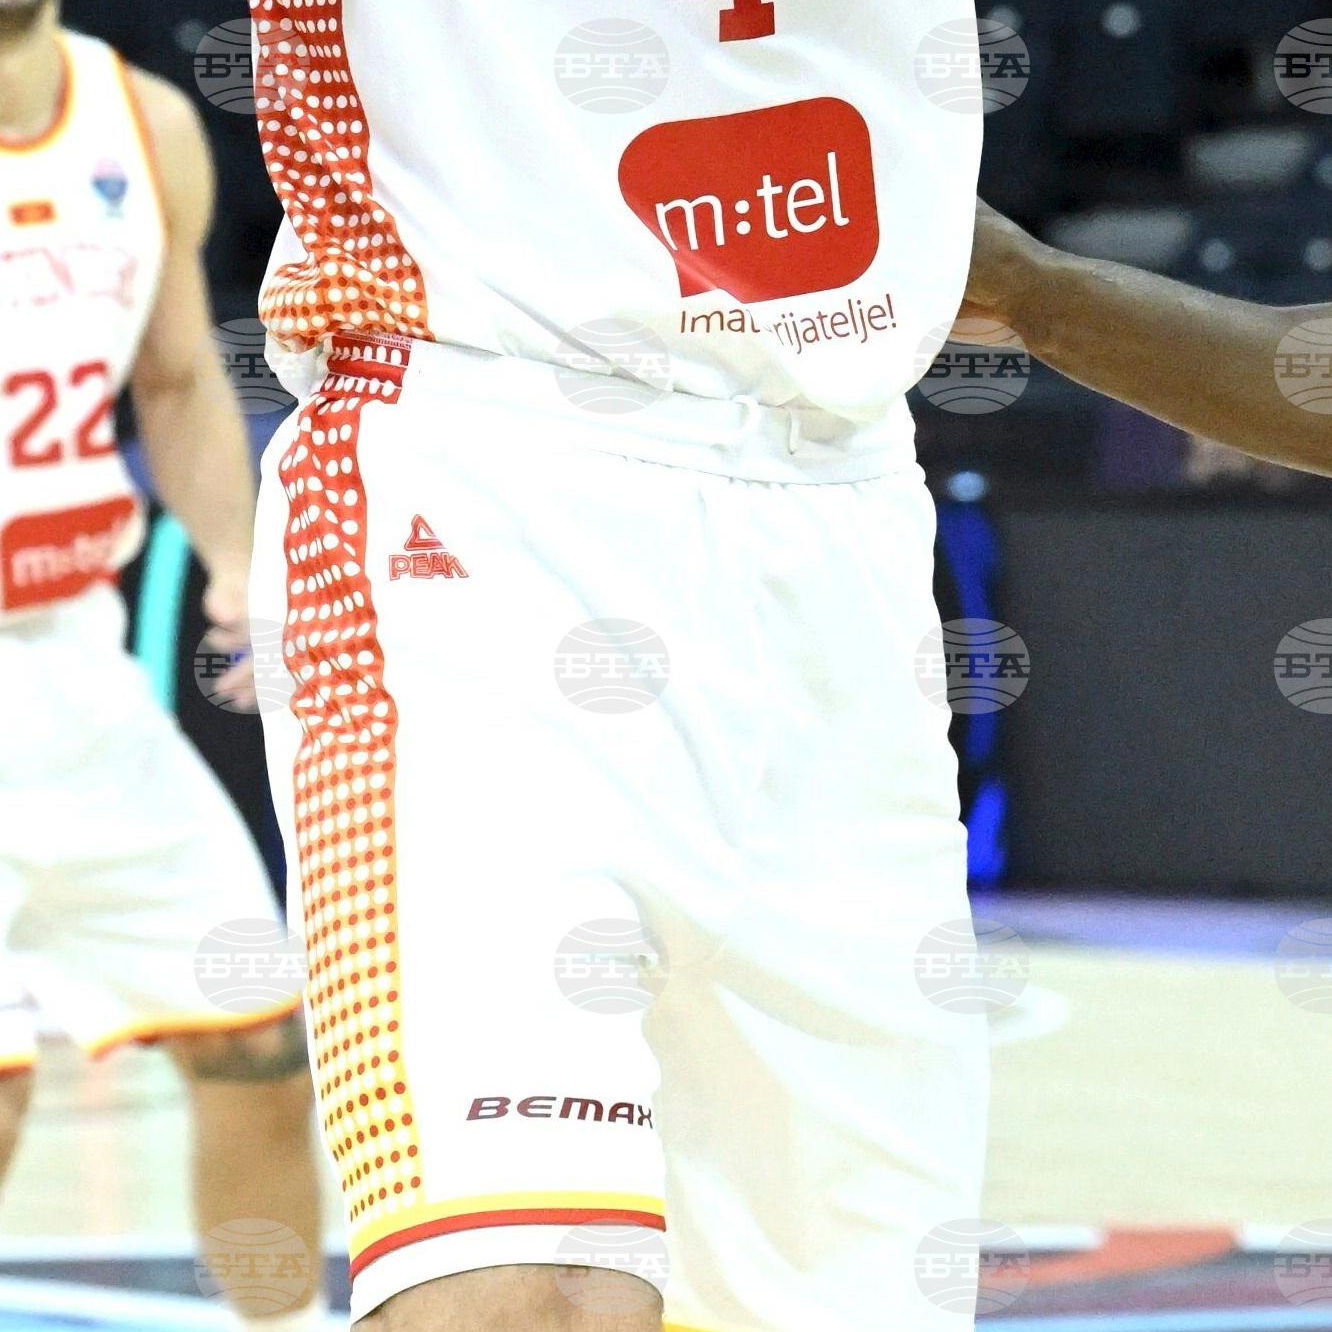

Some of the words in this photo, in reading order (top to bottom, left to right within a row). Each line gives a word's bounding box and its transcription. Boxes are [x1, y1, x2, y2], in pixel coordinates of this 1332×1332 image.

[655, 151, 850, 252] m:tel
[763, 293, 897, 355] rijatelje!
[2, 360, 118, 468] 22
[388, 552, 470, 581] PEAK
[466, 1096, 653, 1129] BEMAX
